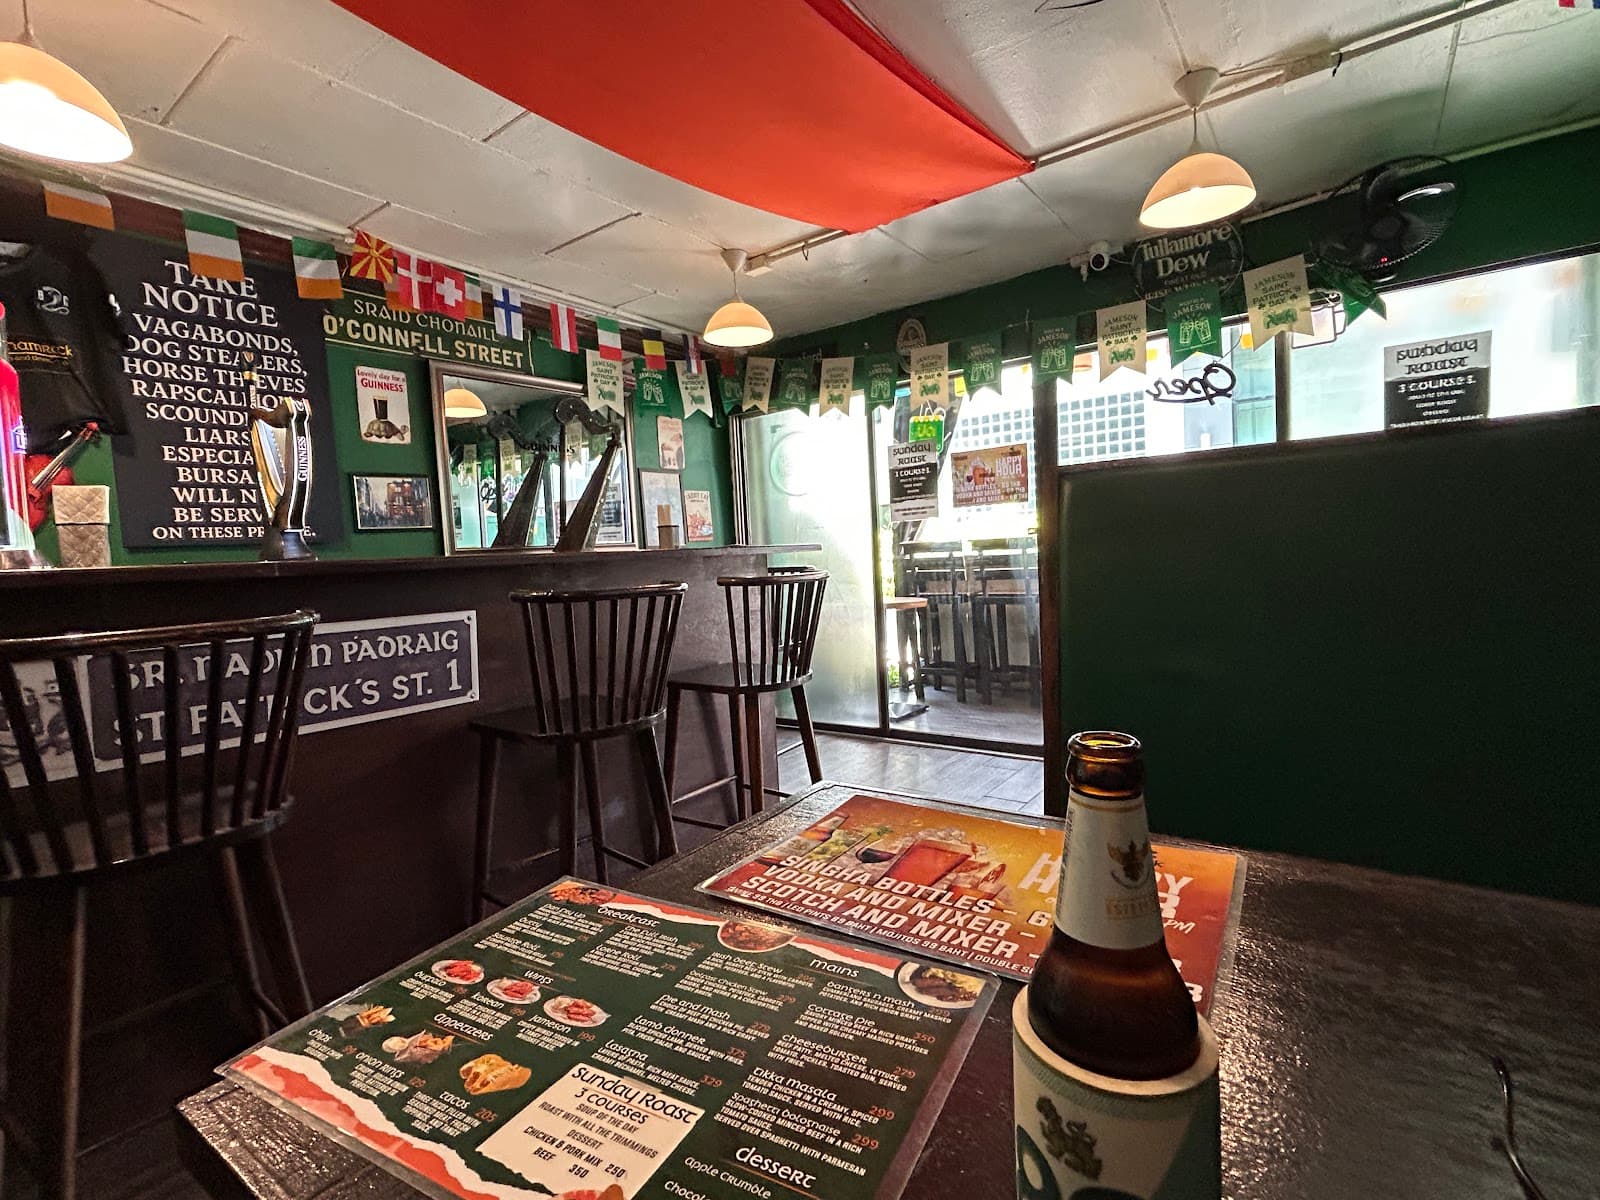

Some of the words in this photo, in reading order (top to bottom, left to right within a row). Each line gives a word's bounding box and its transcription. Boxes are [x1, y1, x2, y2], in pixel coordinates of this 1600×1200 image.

[1140, 225, 1232, 261] Tullamore
[165, 260, 257, 298] TAKE
[1156, 250, 1211, 278] Dew
[142, 282, 278, 328] NOTICE
[1173, 303, 1211, 319] JAMESON
[128, 335, 181, 358] DOG
[133, 313, 298, 356] VAGABONDS,
[323, 315, 449, 355] O'CONNELL
[455, 340, 524, 369] STREET
[121, 356, 209, 383] HORSE
[213, 369, 306, 394] THEVES
[360, 378, 404, 392] GUINNESS
[297, 436, 309, 481] GUINNESS
[171, 487, 234, 504] WILL
[152, 526, 183, 540] ON
[188, 526, 243, 538] THESE
[174, 508, 204, 522] BE
[392, 673, 434, 701] ST.
[447, 659, 463, 693] 1
[764, 865, 844, 893] VODKA
[844, 887, 906, 909] AND
[909, 902, 1011, 936] MIXER
[780, 855, 872, 884] SINGHA
[874, 877, 995, 913] BOTTLES
[742, 877, 844, 910] SCOTCH
[843, 905, 908, 928] AND
[910, 921, 1018, 958] MIXER
[803, 908, 831, 919] PINTS
[876, 928, 921, 943] MOJITOS
[938, 945, 967, 956] BAHT
[974, 954, 1018, 970] DOUBLE
[524, 970, 554, 984] wings
[809, 959, 859, 977] Mains
[471, 992, 504, 1009] korean
[678, 1000, 702, 1010] and
[700, 1006, 730, 1020] Mash
[434, 1013, 493, 1041] appetizers
[528, 1014, 571, 1033] jameson
[634, 1015, 663, 1030] Lamb
[663, 1026, 706, 1045] donner
[355, 1052, 383, 1068] onion
[605, 1039, 648, 1061] Lasagna
[782, 1034, 867, 1064] cheeseburger
[439, 1091, 470, 1109] tacos
[572, 1067, 640, 1103] Sunday
[638, 1093, 697, 1124] Roast
[574, 1087, 589, 1098] 3
[587, 1094, 649, 1124] courses
[753, 1067, 785, 1083] tikka
[786, 1078, 837, 1101] Masala
[867, 1104, 896, 1121] 299
[538, 1101, 564, 1116] ROAST
[562, 1112, 583, 1125] WITH
[580, 1120, 596, 1131] ALL
[595, 1126, 612, 1138] THE
[610, 1133, 658, 1158] TRIMMINGS
[576, 1103, 598, 1116] SOUP
[595, 1111, 609, 1120] OF
[607, 1116, 624, 1128] THE
[621, 1122, 639, 1133] DAY
[731, 1092, 780, 1114] Spaghetti
[781, 1109, 840, 1136] bolognaise
[850, 1133, 880, 1152] 299
[776, 1118, 806, 1133] MINCED
[805, 1128, 826, 1140] BEEF
[825, 1135, 836, 1144] IN
[835, 1139, 842, 1147] A
[842, 1142, 862, 1154] RICH
[523, 1126, 558, 1145] CHICKEN
[562, 1144, 586, 1159] PORK
[583, 1154, 603, 1167] MIX
[604, 1163, 626, 1178] 250
[567, 1129, 603, 1149] DESSERT
[713, 1113, 742, 1128] SERVED
[740, 1123, 761, 1135] OVER
[760, 1131, 800, 1150] SPAGHETTI
[800, 1145, 821, 1159] WITH
[821, 1154, 866, 1176] PARMESAN
[533, 1147, 556, 1161] BEEF
[568, 1164, 589, 1178] 350
[684, 1157, 719, 1177] apple
[717, 1169, 774, 1200] Crumble
[736, 1147, 816, 1188] dessert
